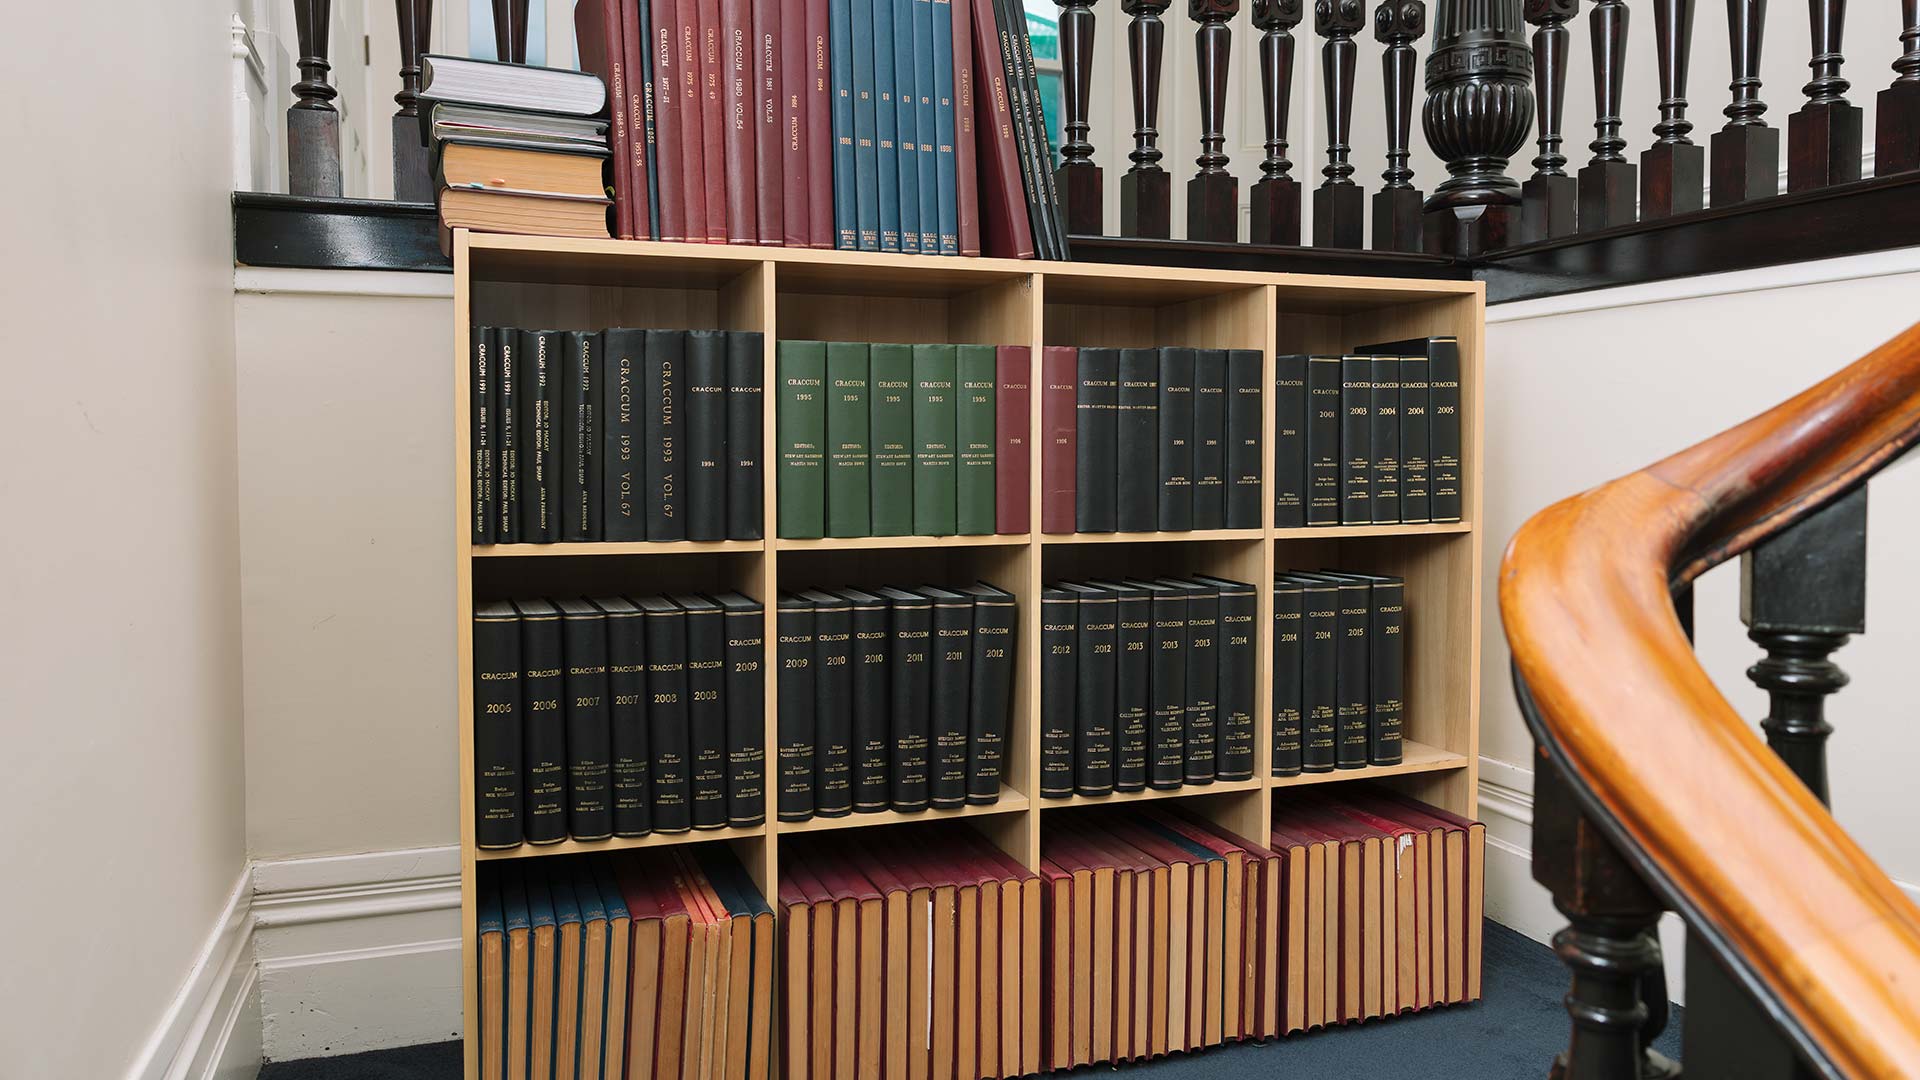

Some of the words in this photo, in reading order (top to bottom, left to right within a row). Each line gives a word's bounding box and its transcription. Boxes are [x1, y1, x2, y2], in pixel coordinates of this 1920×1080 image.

[660, 28, 668, 66] CRACCUM
[684, 26, 692, 62] CRACCUM
[1002, 30, 1010, 60] CRACCUM
[1024, 34, 1032, 63] CRACCUM
[1012, 34, 1022, 65] CRACCUM
[614, 62, 622, 98] CRACCUM
[994, 76, 1005, 112] CRACCUM
[644, 82, 654, 121] CRACCUM
[478, 343, 486, 376] CRACCUM
[504, 345, 512, 378] CRACCUM
[620, 358, 630, 422] CRACCUM
[662, 361, 672, 425] CRACCUM
[621, 435, 630, 460] 1993
[664, 437, 672, 462] 1993
[621, 472, 630, 500] VOL.
[664, 474, 672, 500] VOL.
[622, 503, 630, 516] 67
[664, 504, 672, 518] 67
[1315, 632, 1331, 640] 2014
[1348, 628, 1364, 636] 2015
[729, 638, 761, 647] CRACCUM
[819, 634, 850, 642] CRACCUM
[1194, 638, 1210, 648] 2013
[1231, 636, 1248, 645] 2014
[1282, 634, 1297, 642] 2014
[1094, 645, 1112, 654] 2012
[1128, 642, 1144, 651] 2013
[1162, 640, 1178, 649] 2013
[986, 649, 1004, 658] 2012
[1052, 646, 1070, 654] 2012
[826, 656, 846, 666] 2010
[864, 654, 884, 664] 2010
[906, 653, 923, 662] 2011
[946, 652, 962, 660] 2011
[649, 664, 682, 672] CRACCUM
[689, 661, 722, 669] CRACCUM
[736, 662, 758, 672] 2009
[786, 658, 808, 668] 2009
[570, 666, 605, 675] CRACCUM
[610, 664, 643, 673] CRACCUM
[481, 672, 518, 680] CRACCUM
[528, 670, 561, 678] CRACCUM
[616, 694, 638, 705] 2007
[654, 694, 677, 703] 2008
[694, 691, 718, 701] 2008
[533, 700, 557, 711] 2006
[576, 696, 600, 707] 2007
[486, 704, 512, 714] 2006
